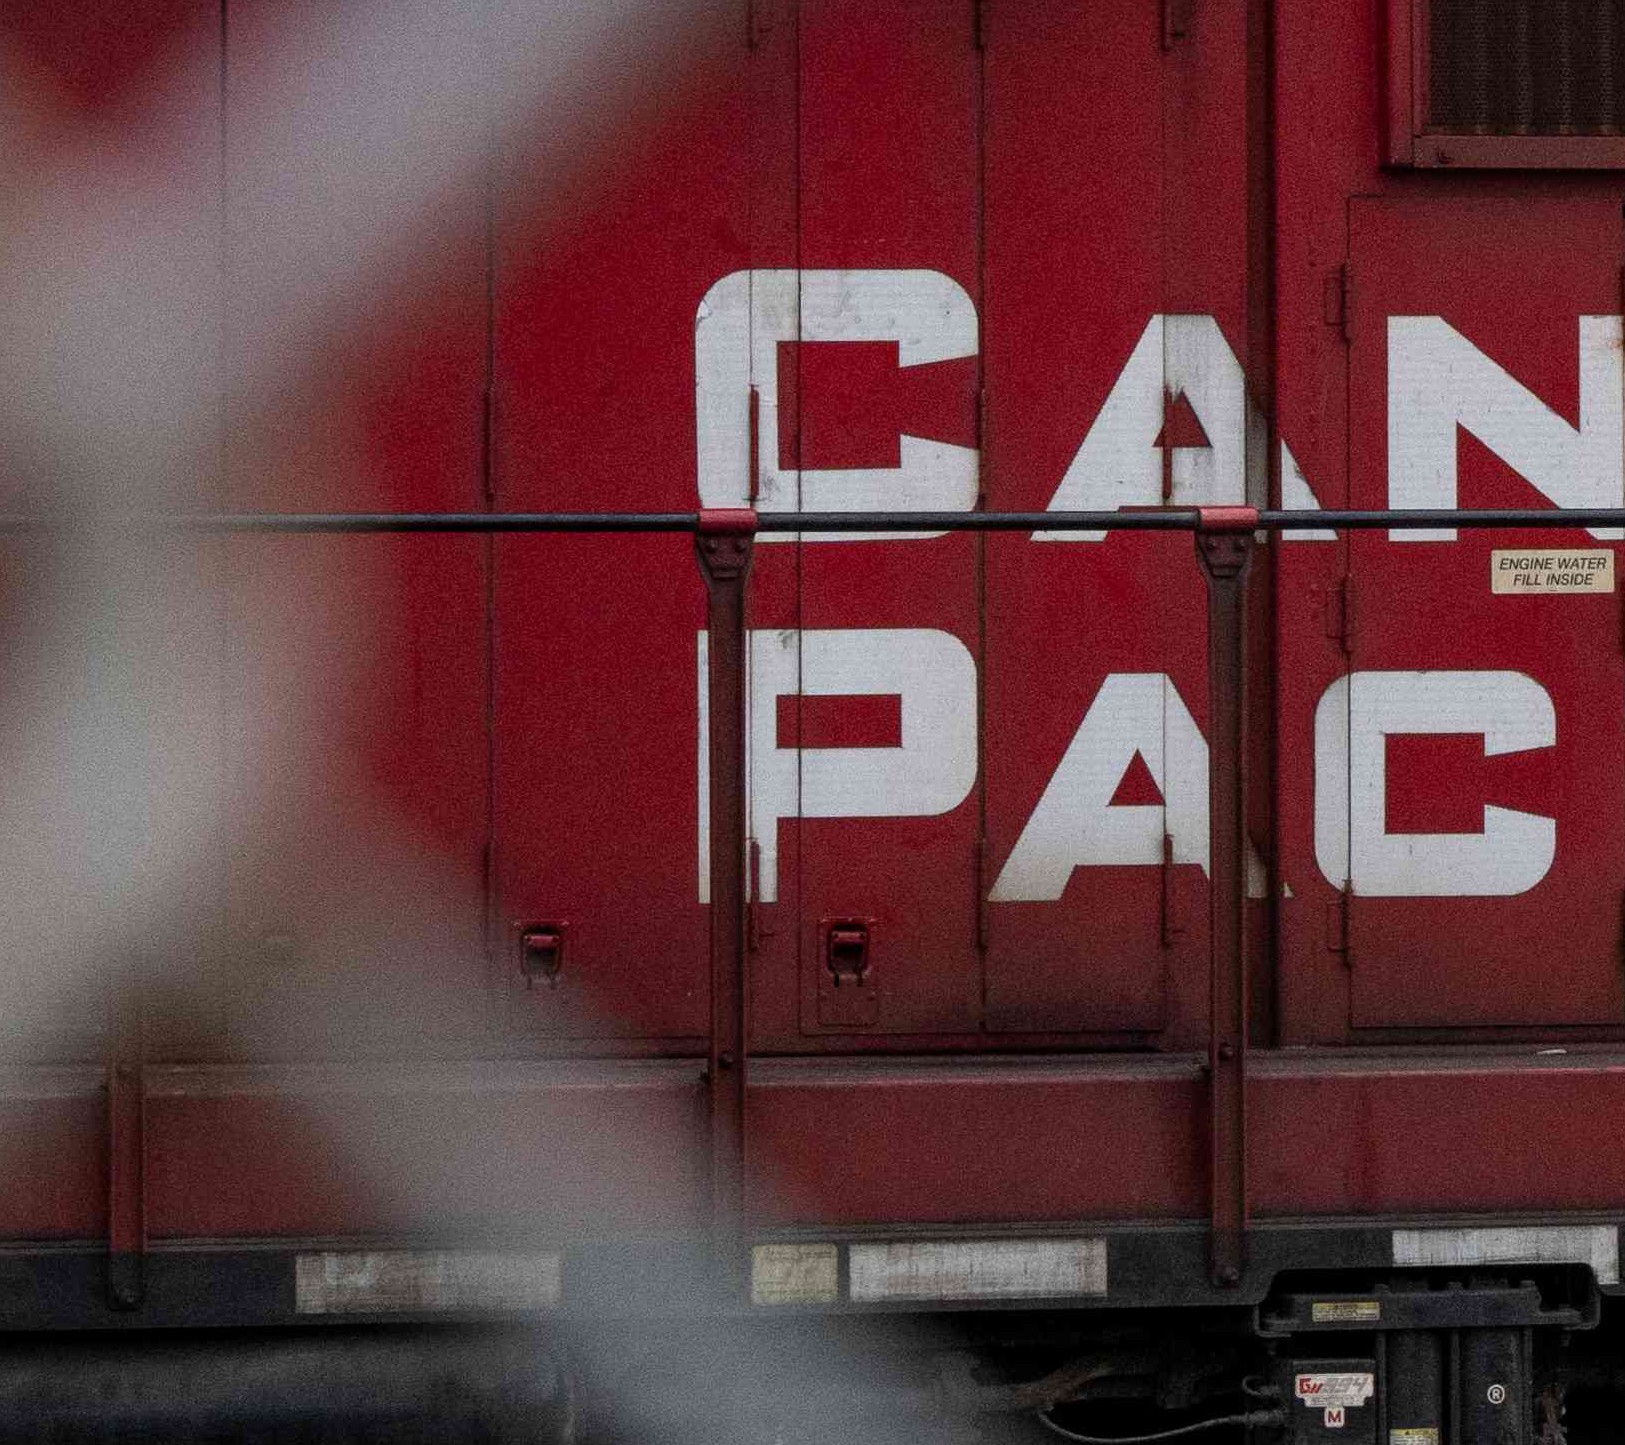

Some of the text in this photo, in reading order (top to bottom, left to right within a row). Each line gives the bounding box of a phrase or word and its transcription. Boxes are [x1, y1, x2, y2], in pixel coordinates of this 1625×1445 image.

[1499, 557, 1607, 571] ENGINE WATER
[1513, 572, 1595, 586] FILL INSIDE
